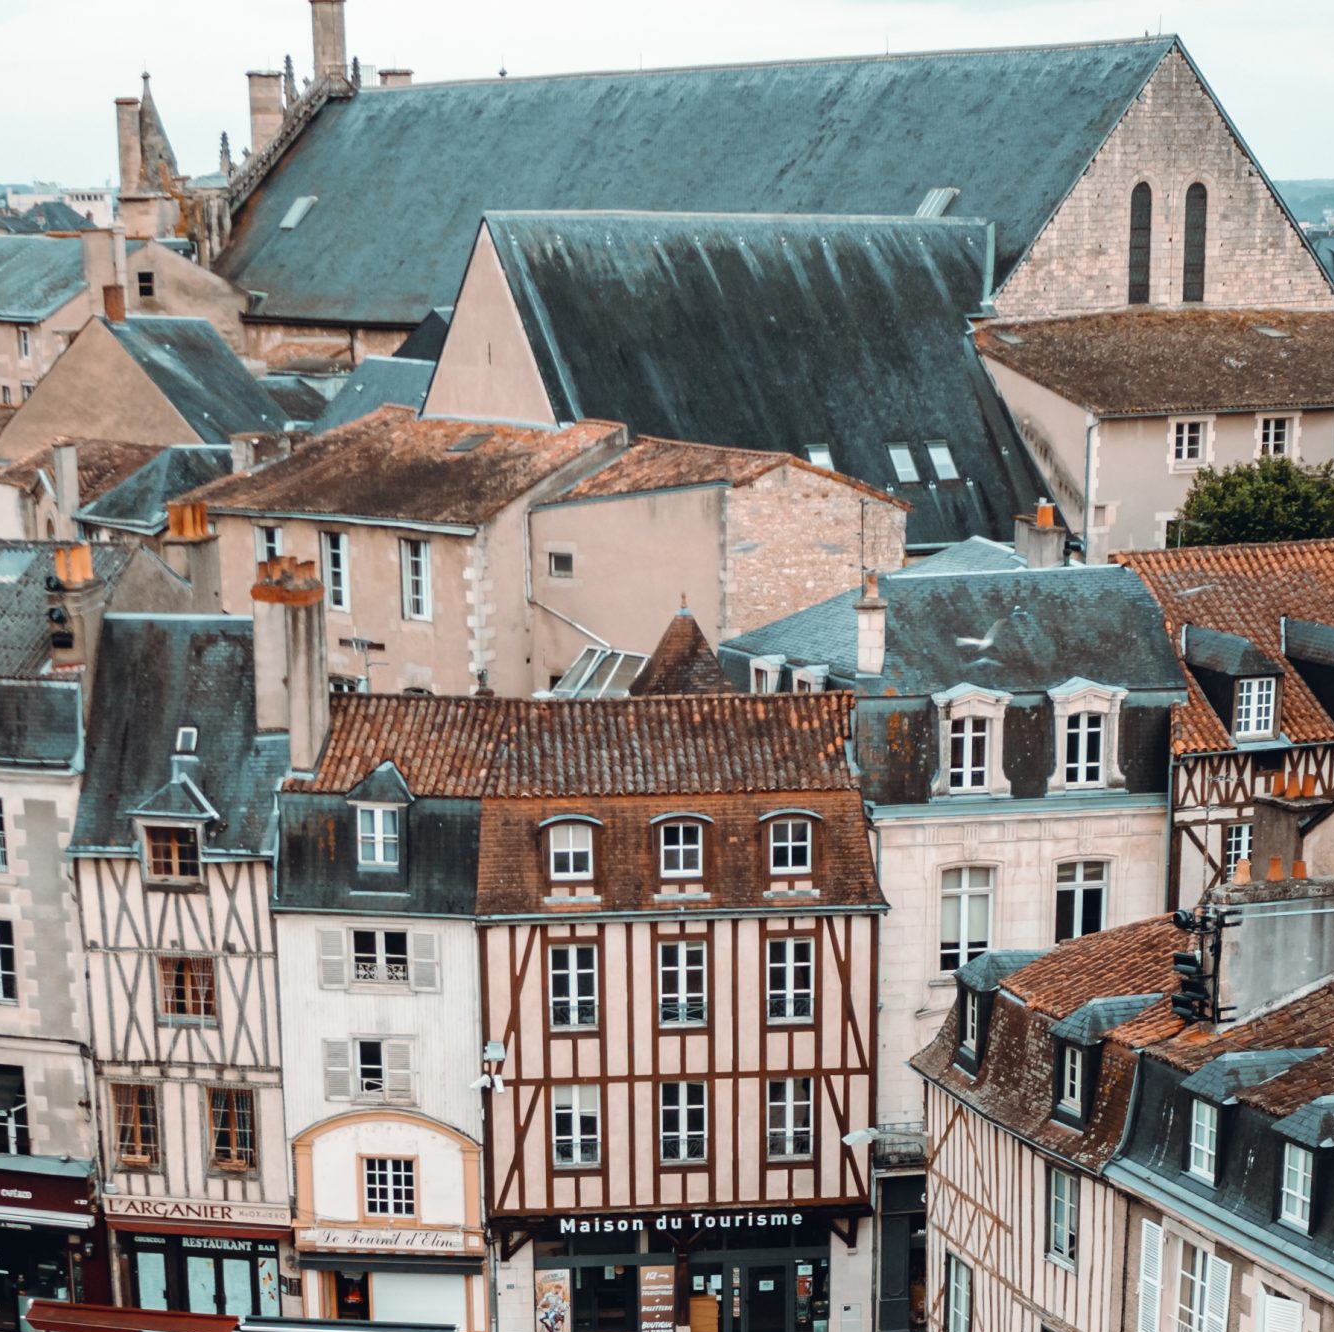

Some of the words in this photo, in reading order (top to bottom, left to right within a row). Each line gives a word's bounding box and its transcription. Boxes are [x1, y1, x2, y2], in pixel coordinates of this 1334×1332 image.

[109, 1199, 234, 1220] L'ARGANIER
[560, 1218, 644, 1234] Maison
[655, 1215, 683, 1230] du
[691, 1212, 803, 1229] Tourisme
[182, 1236, 253, 1252] RESTAURANT
[258, 1244, 276, 1252] BAR
[322, 1230, 340, 1244] Le
